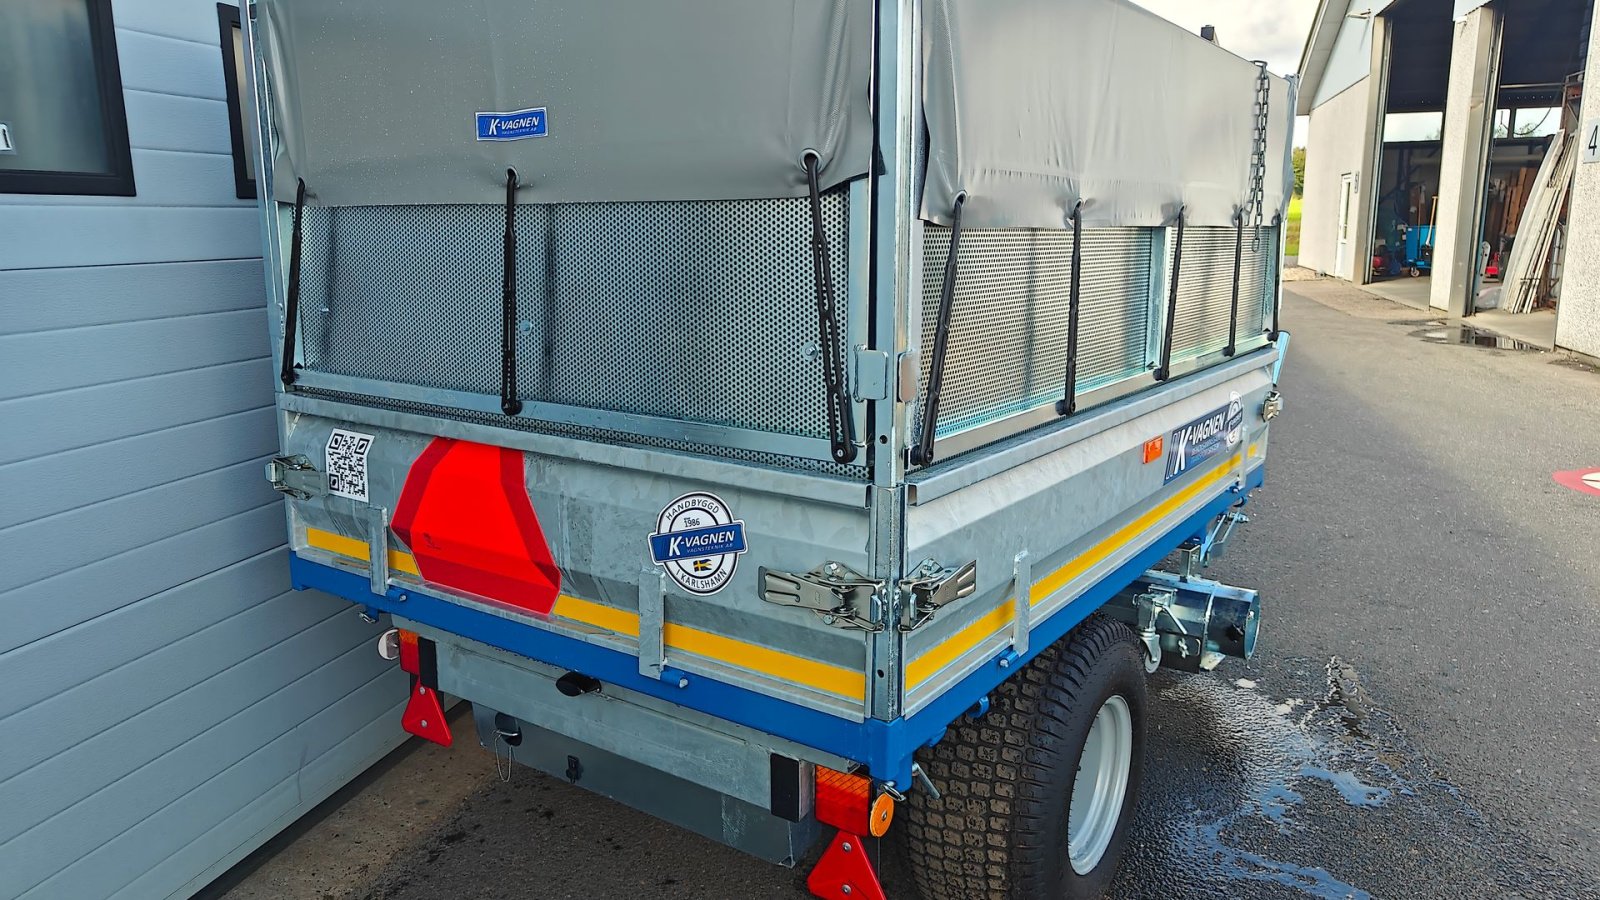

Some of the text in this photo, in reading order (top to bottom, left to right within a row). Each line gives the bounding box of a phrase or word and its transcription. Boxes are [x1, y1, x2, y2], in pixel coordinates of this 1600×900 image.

[489, 116, 539, 135] K-VAGNEN
[1588, 125, 1598, 156] 4
[1174, 411, 1226, 475] K-VAGNEN
[665, 499, 719, 520] HANDBYGGD
[684, 518, 700, 528] 1986
[668, 531, 735, 557] K-VAGNEN
[680, 568, 727, 588] KARLSHAMN
